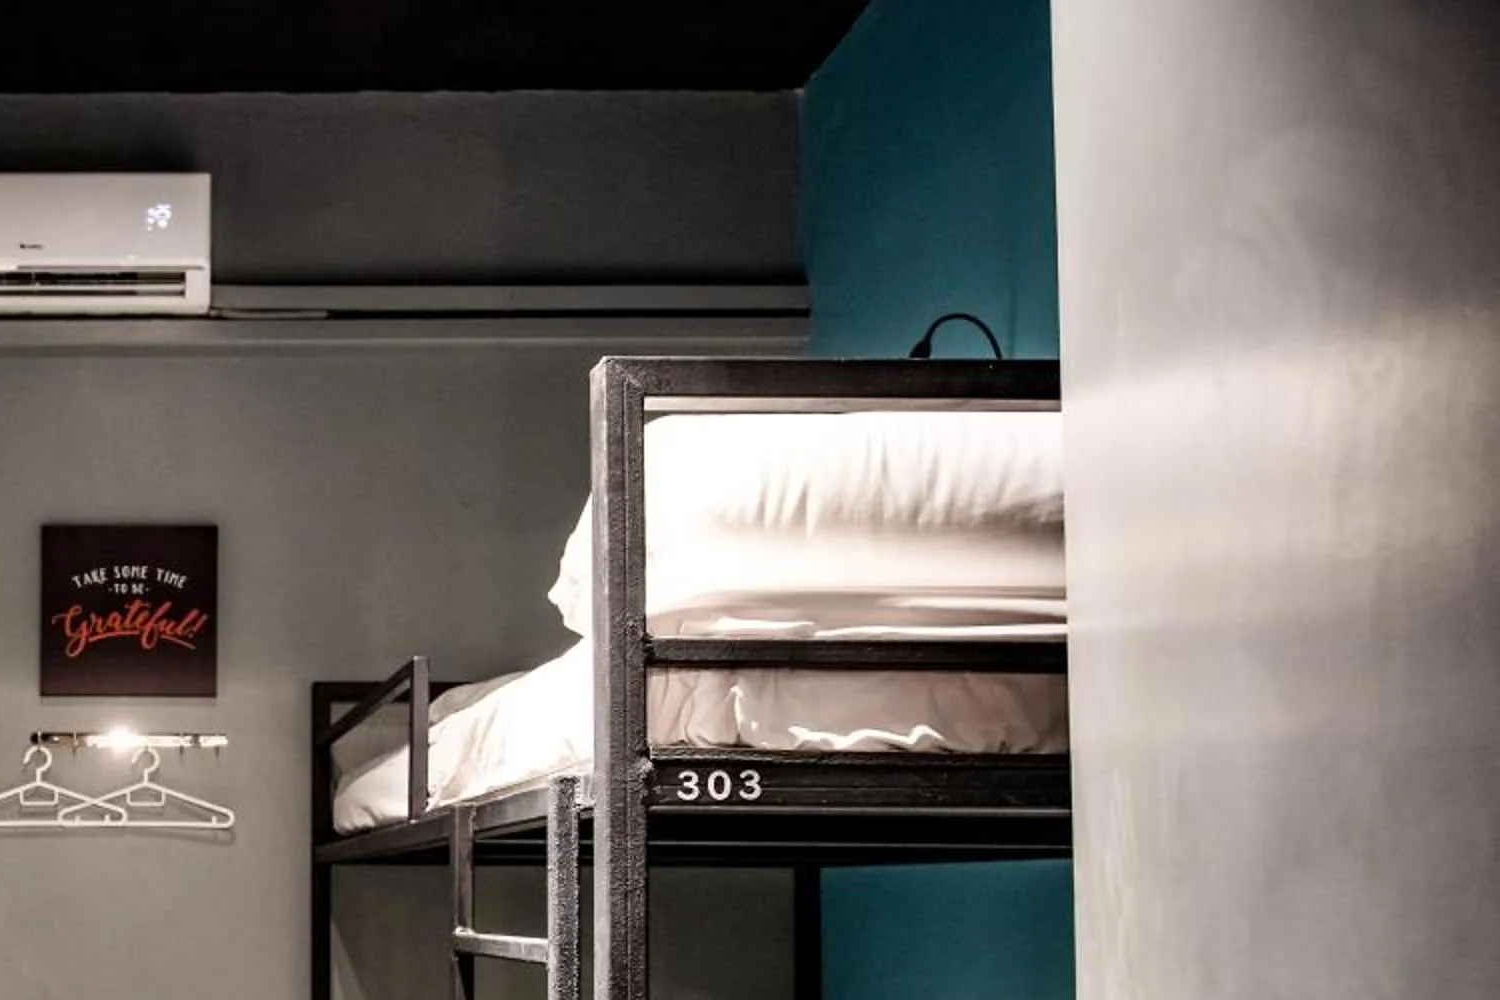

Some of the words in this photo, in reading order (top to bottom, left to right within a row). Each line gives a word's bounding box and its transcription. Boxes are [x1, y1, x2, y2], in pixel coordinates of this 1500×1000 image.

[71, 567, 108, 588] TAKE
[113, 565, 148, 579] SOME
[156, 567, 188, 588] TIME
[52, 599, 208, 657] Grateful!
[677, 769, 762, 801] 303
